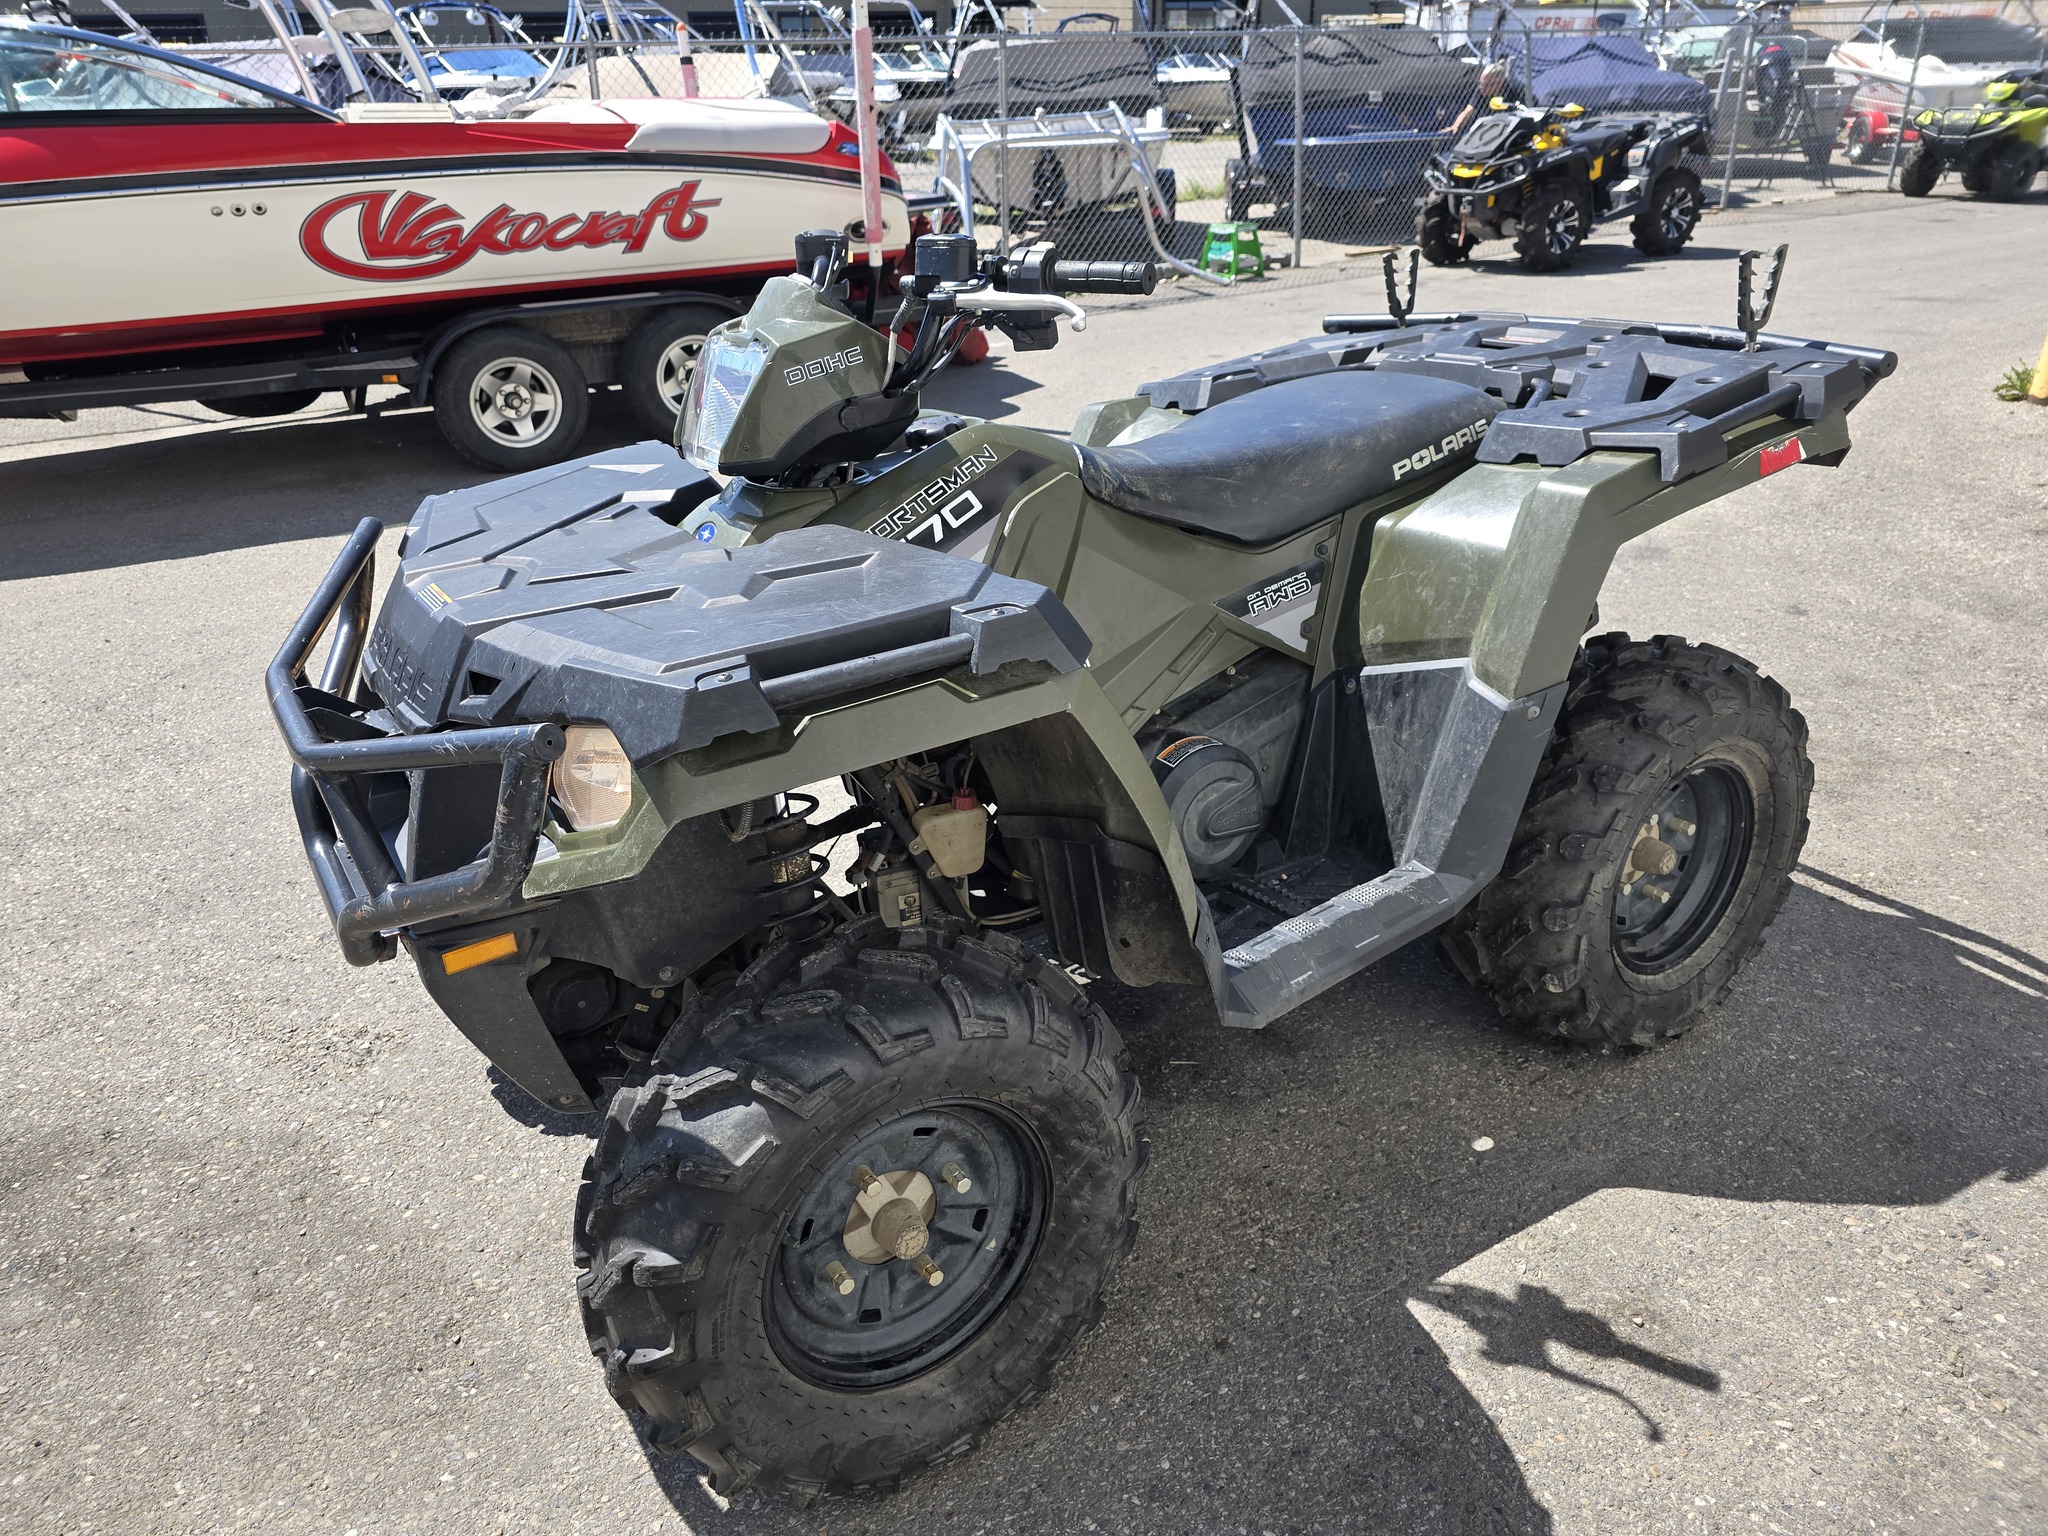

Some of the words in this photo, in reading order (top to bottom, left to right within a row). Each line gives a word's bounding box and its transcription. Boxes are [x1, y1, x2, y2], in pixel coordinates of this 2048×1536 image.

[1534, 16, 1552, 31] CP
[1551, 16, 1577, 31] Rail
[783, 345, 864, 387] DOHC
[1392, 418, 1489, 481] POLARIS
[863, 443, 998, 540] ORTSMAN
[898, 489, 984, 544] 70
[1248, 578, 1312, 617] AWD
[1263, 571, 1308, 594] DEMAND
